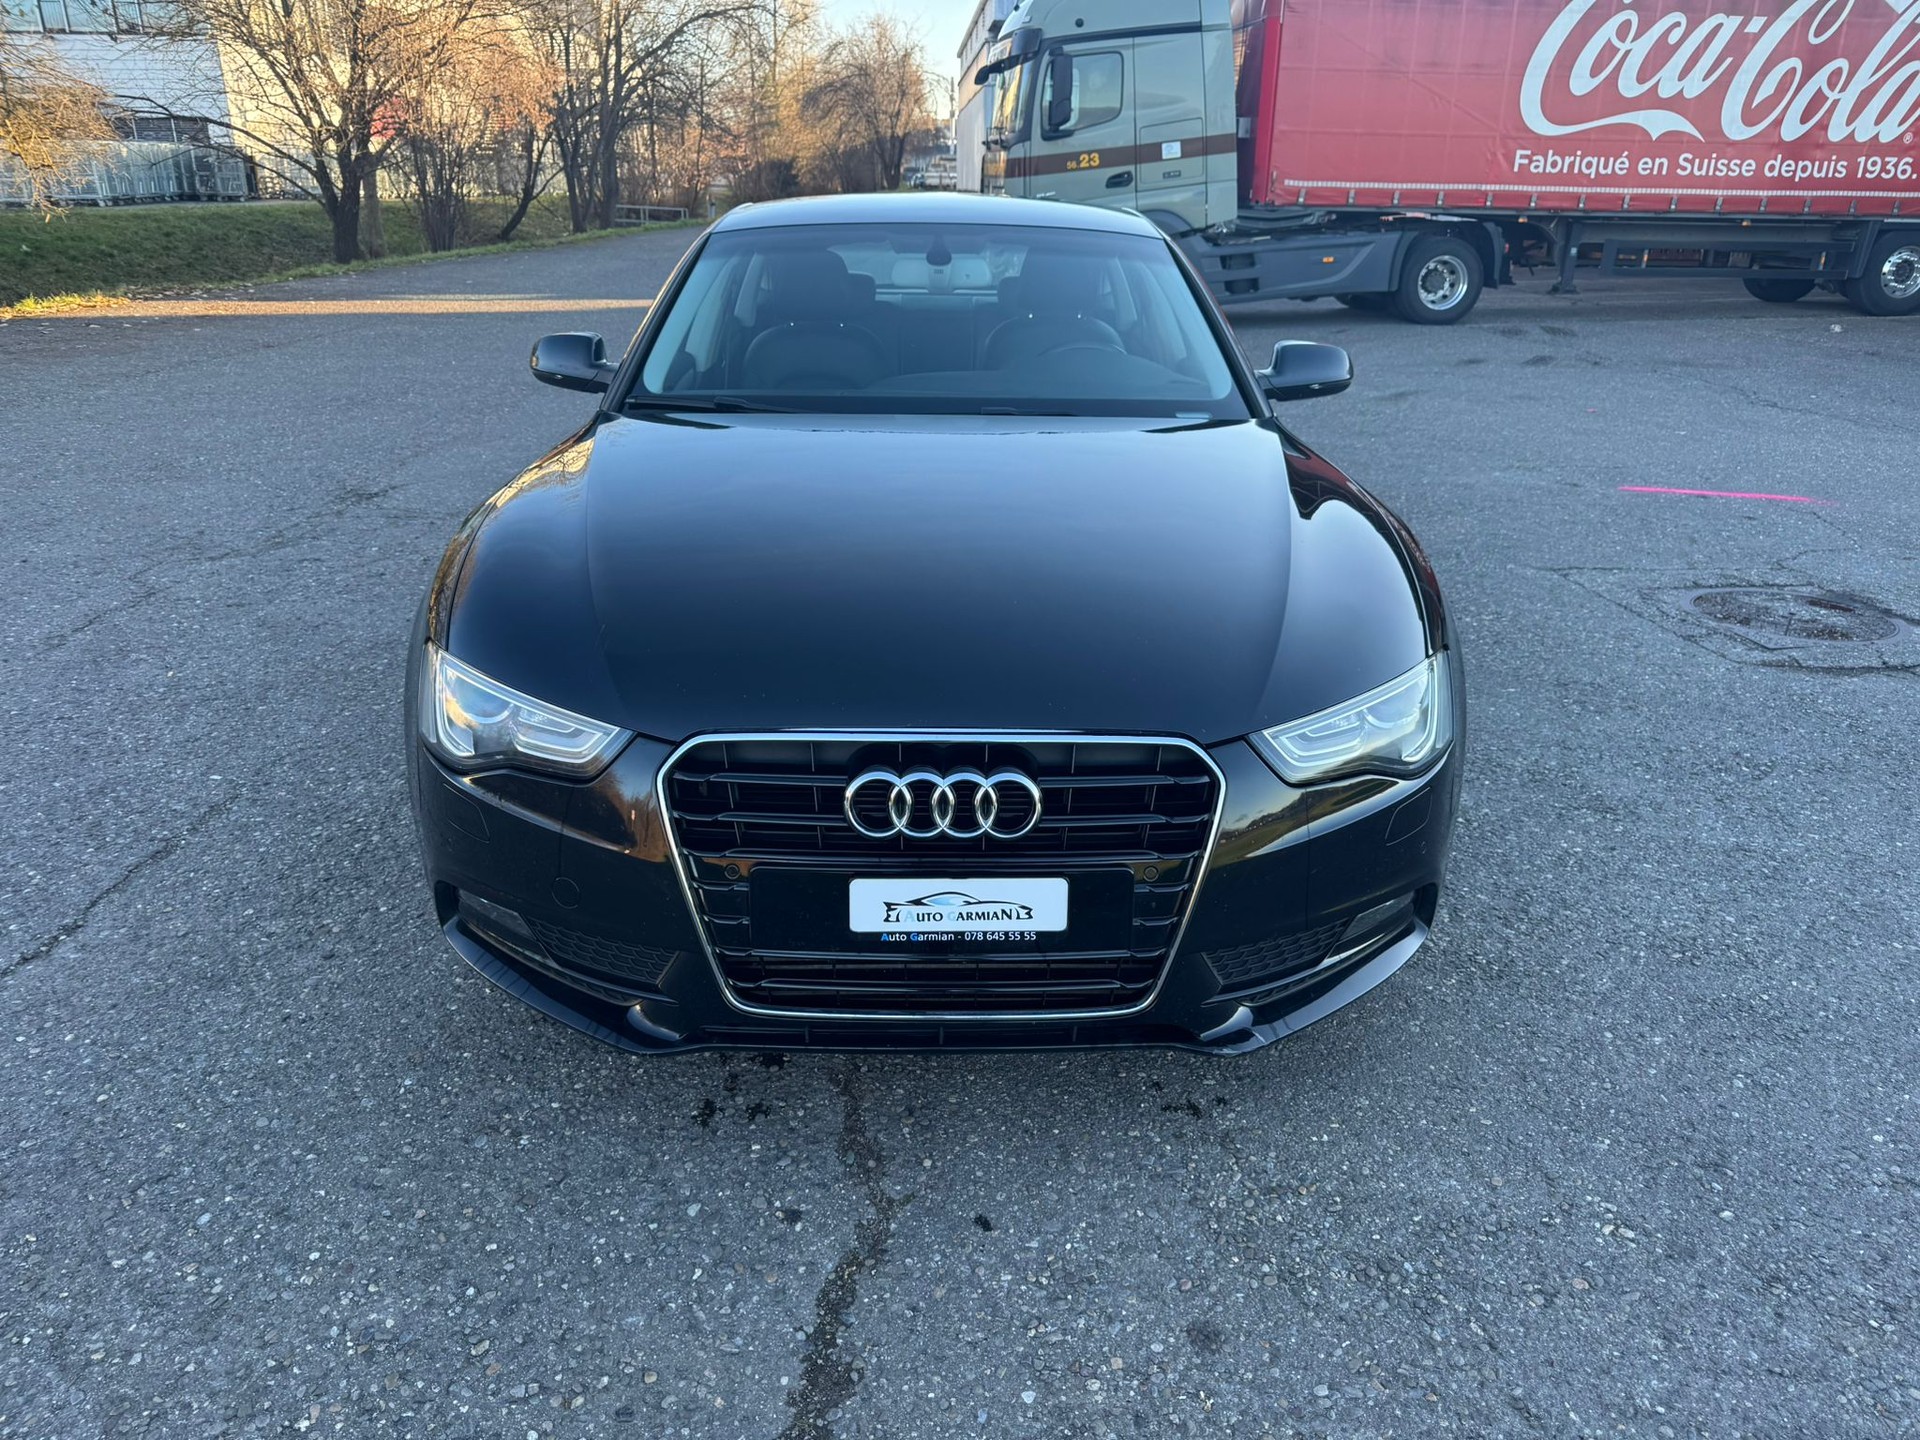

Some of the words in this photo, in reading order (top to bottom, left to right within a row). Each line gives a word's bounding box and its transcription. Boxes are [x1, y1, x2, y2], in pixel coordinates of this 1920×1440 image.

[1513, 149, 1629, 179] Fabriqué
[1637, 157, 1669, 176] en
[1676, 153, 1758, 177] Suisse
[1763, 154, 1848, 182] depuis
[1857, 156, 1918, 180] 1936.
[881, 932, 907, 941] Auto
[910, 931, 955, 941] Garmian
[964, 931, 984, 941] 078
[986, 931, 1005, 941] 645
[1008, 931, 1021, 941] 55
[1024, 931, 1037, 941] 55
